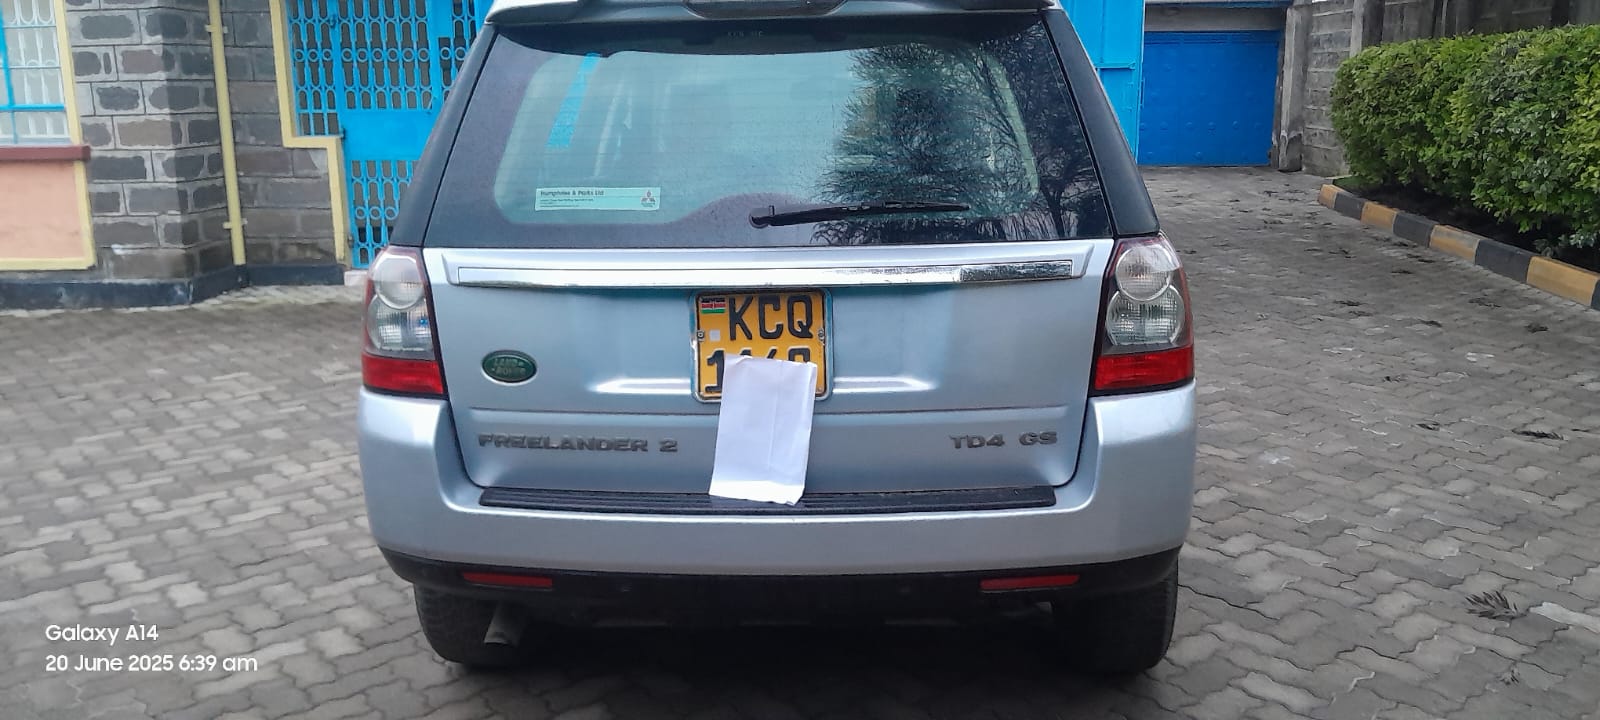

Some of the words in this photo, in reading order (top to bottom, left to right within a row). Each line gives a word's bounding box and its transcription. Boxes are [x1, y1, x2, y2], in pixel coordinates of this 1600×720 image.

[728, 295, 813, 341] KCQ
[478, 434, 649, 452] FREELANDER
[659, 438, 678, 452] 2
[949, 434, 1005, 449] TD4
[1019, 431, 1058, 446] GS
